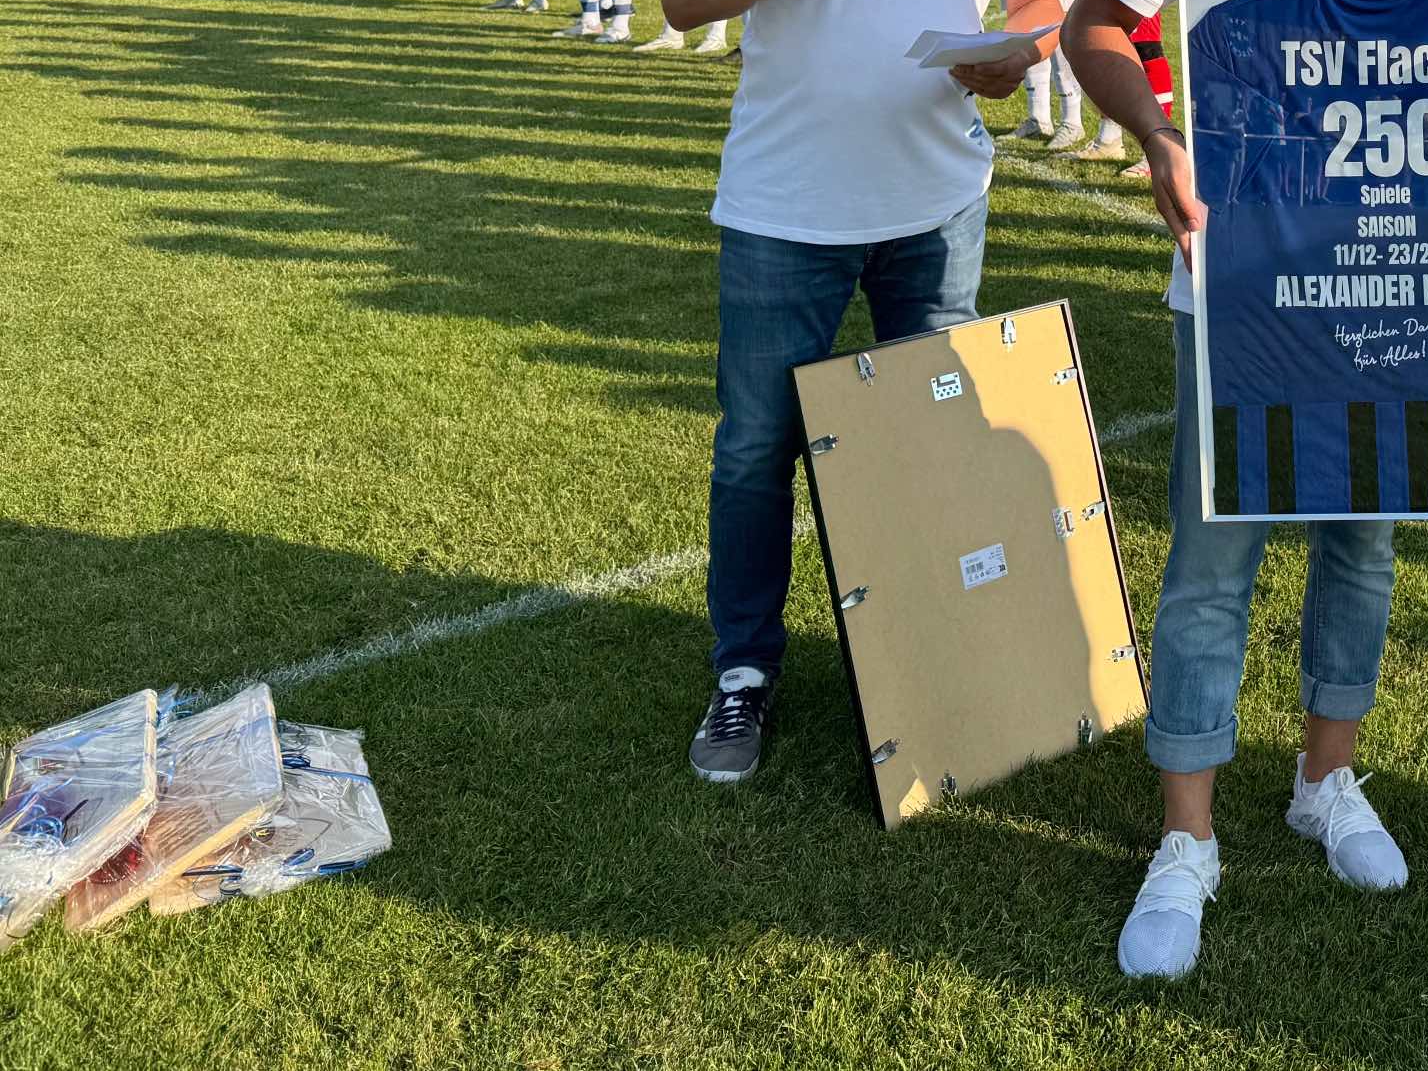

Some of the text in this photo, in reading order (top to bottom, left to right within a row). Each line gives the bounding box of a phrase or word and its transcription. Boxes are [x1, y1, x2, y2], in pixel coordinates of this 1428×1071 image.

[1280, 40, 1346, 86] TSV
[1360, 184, 1412, 207] Spiele
[1357, 215, 1417, 238] SAISON
[1333, 244, 1383, 266] 11/12-
[1275, 274, 1415, 308] ALEXANDER
[1334, 319, 1400, 347] Herzlichen
[1354, 340, 1426, 372] für Alles!
